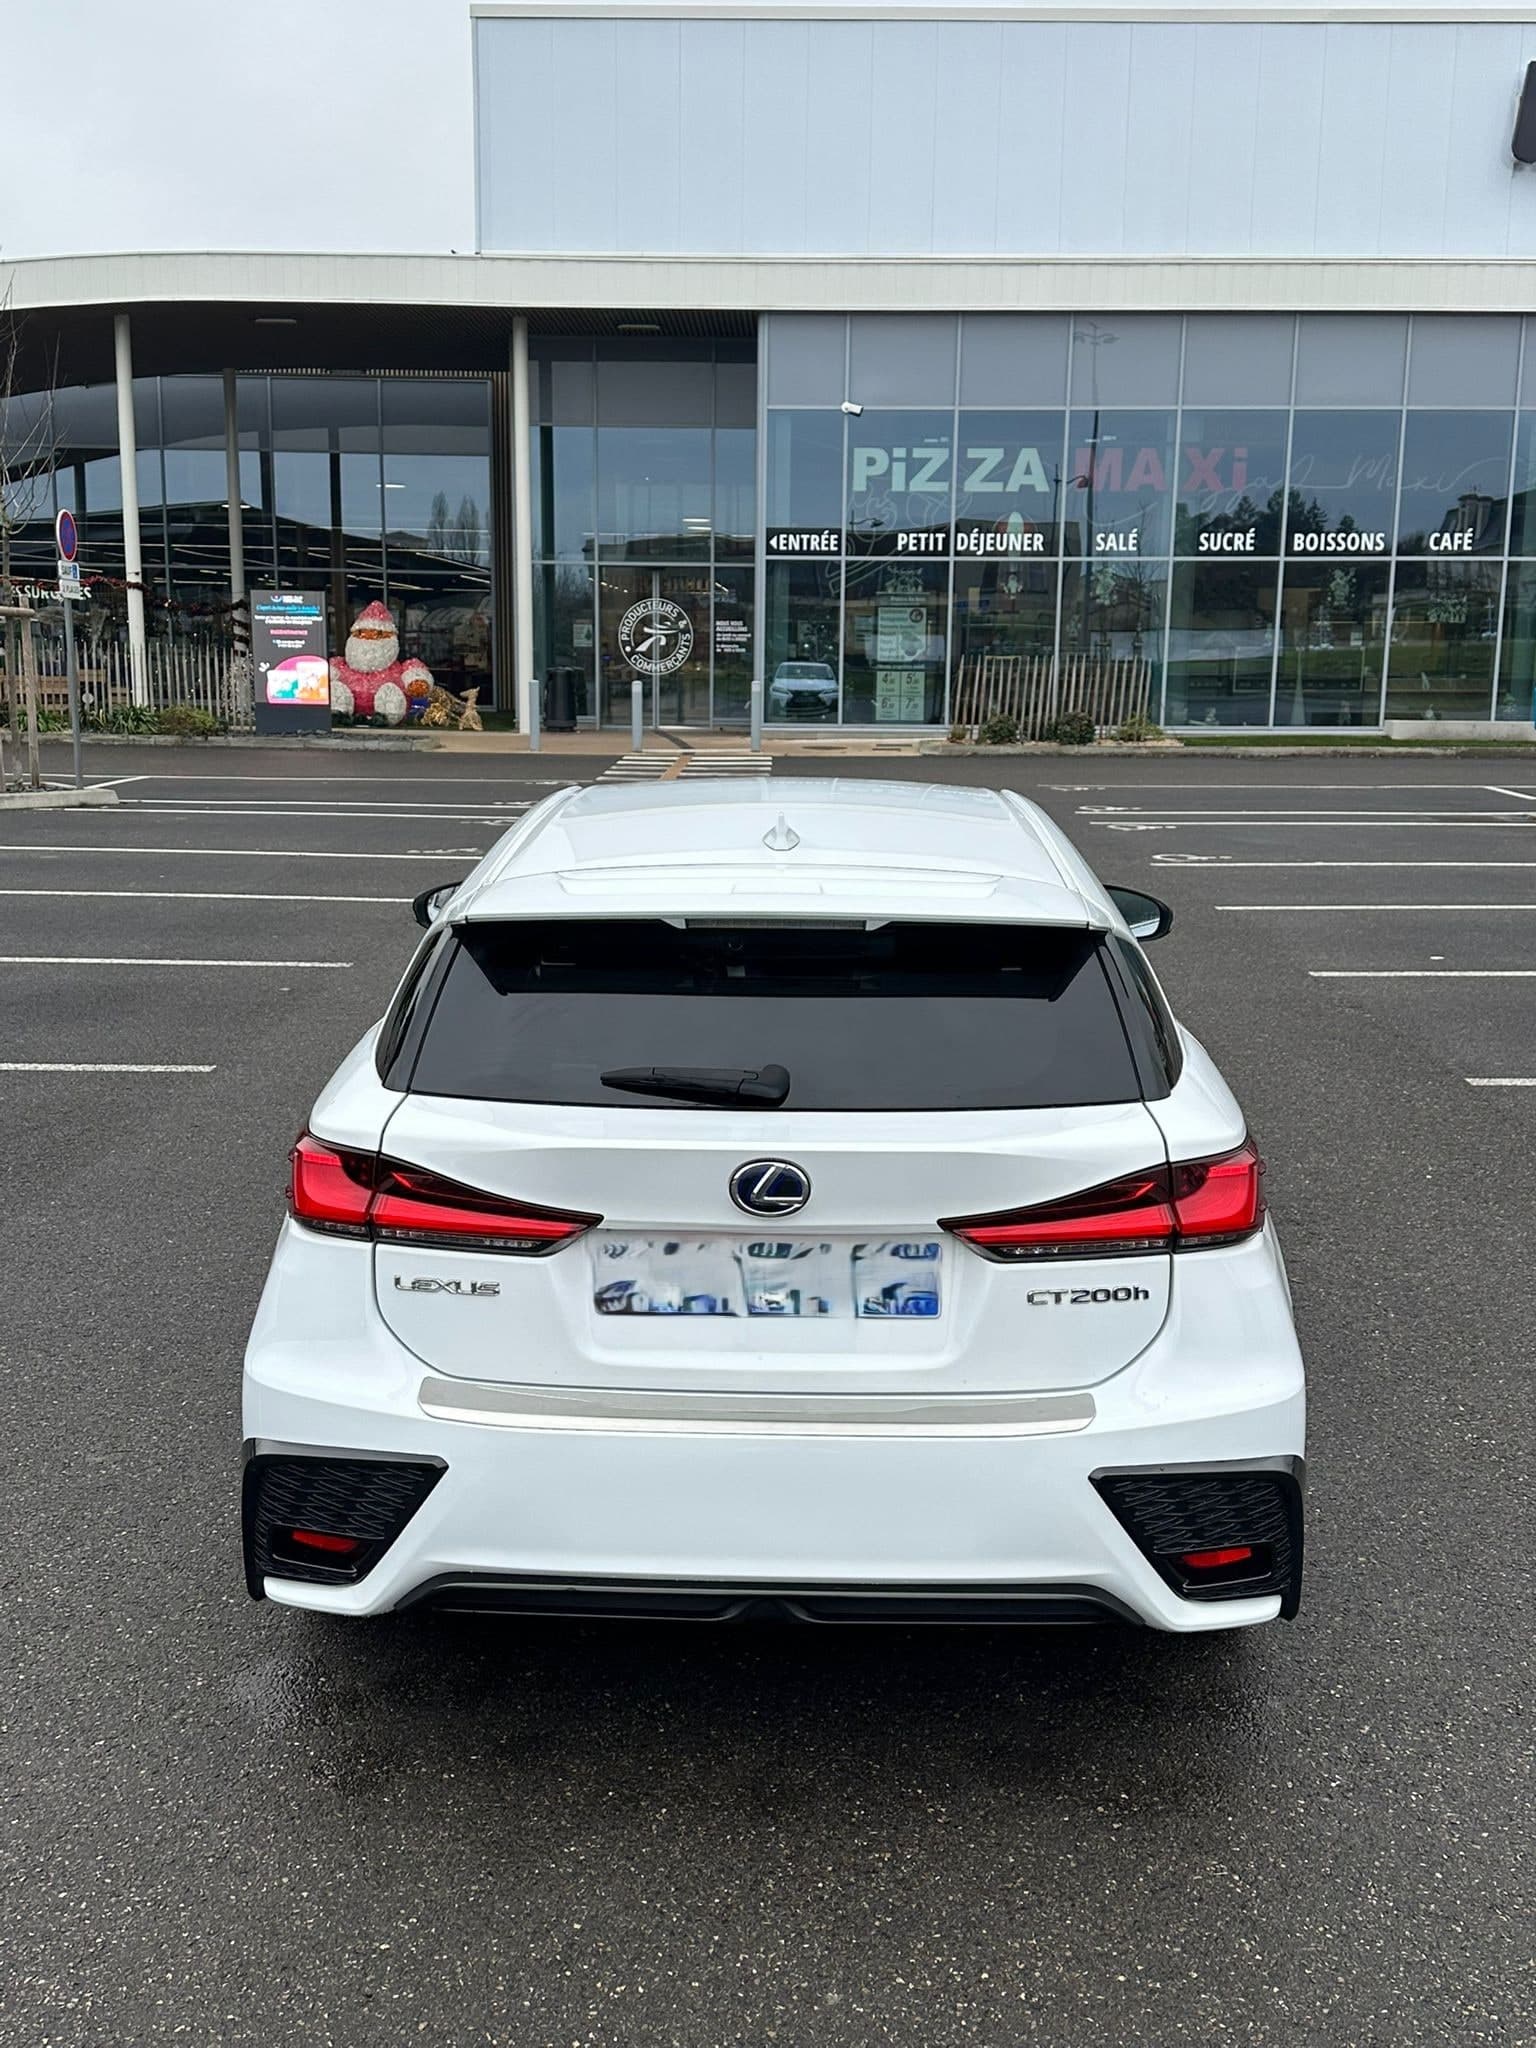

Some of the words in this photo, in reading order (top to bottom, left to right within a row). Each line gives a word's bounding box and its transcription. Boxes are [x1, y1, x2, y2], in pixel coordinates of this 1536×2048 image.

[778, 530, 839, 551] ENTRÉE
[897, 533, 946, 551] PETIT
[956, 528, 1045, 555] DÉJEUNER
[1095, 528, 1139, 551] SALÉ
[1198, 528, 1256, 551] SUCRÉ
[1293, 532, 1386, 551] BOISSONS
[1429, 528, 1474, 551] CAFÉ
[621, 601, 680, 641] PRODUCTEURS
[394, 1274, 500, 1296] LEXUS
